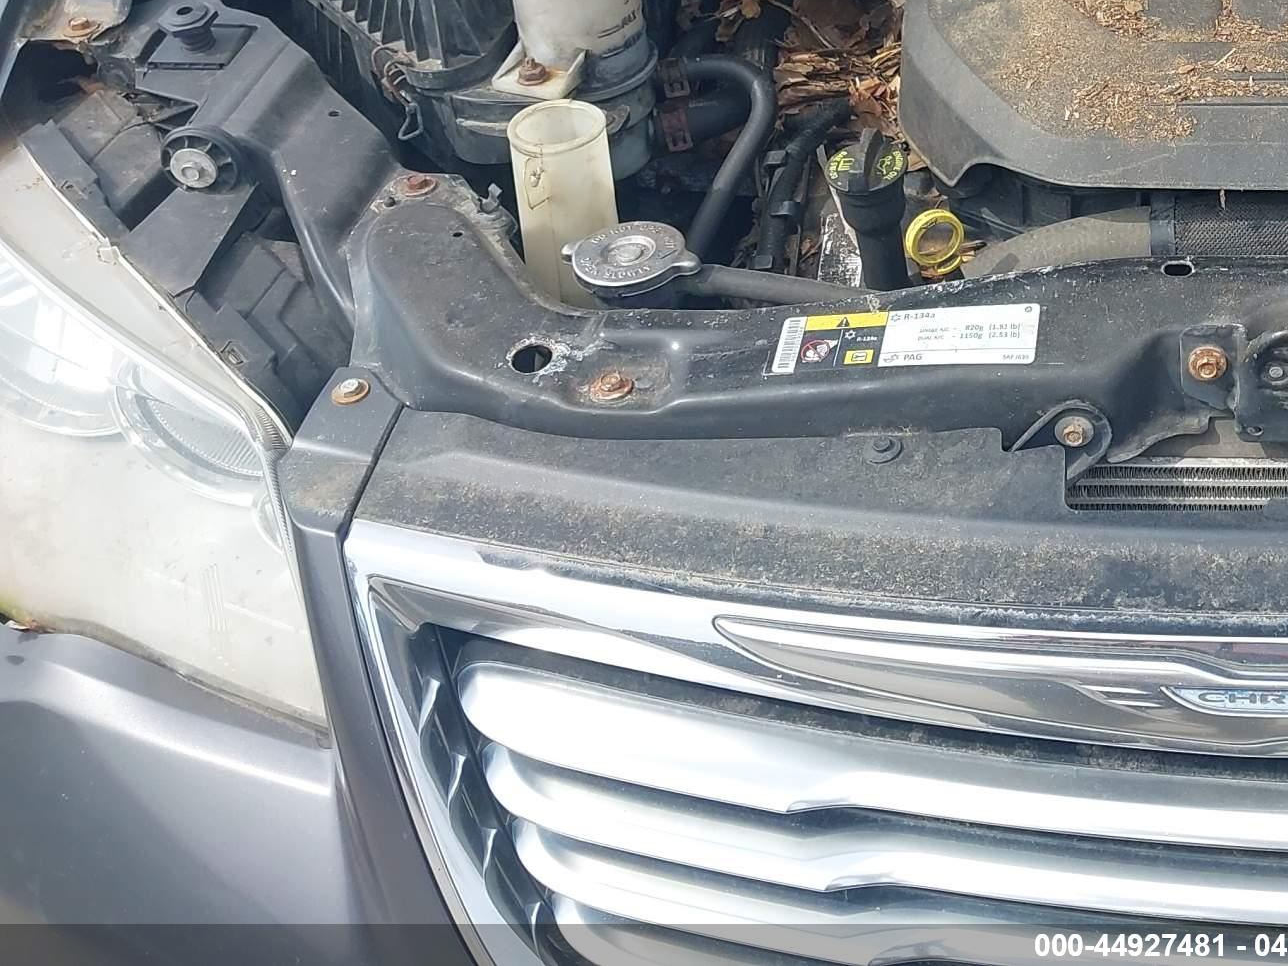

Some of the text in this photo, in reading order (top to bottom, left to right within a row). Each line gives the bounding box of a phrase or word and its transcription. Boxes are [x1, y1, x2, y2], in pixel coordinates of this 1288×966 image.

[883, 150, 903, 181] ENGINE OIL
[904, 312, 936, 321] R-134a
[903, 353, 923, 361] PAG
